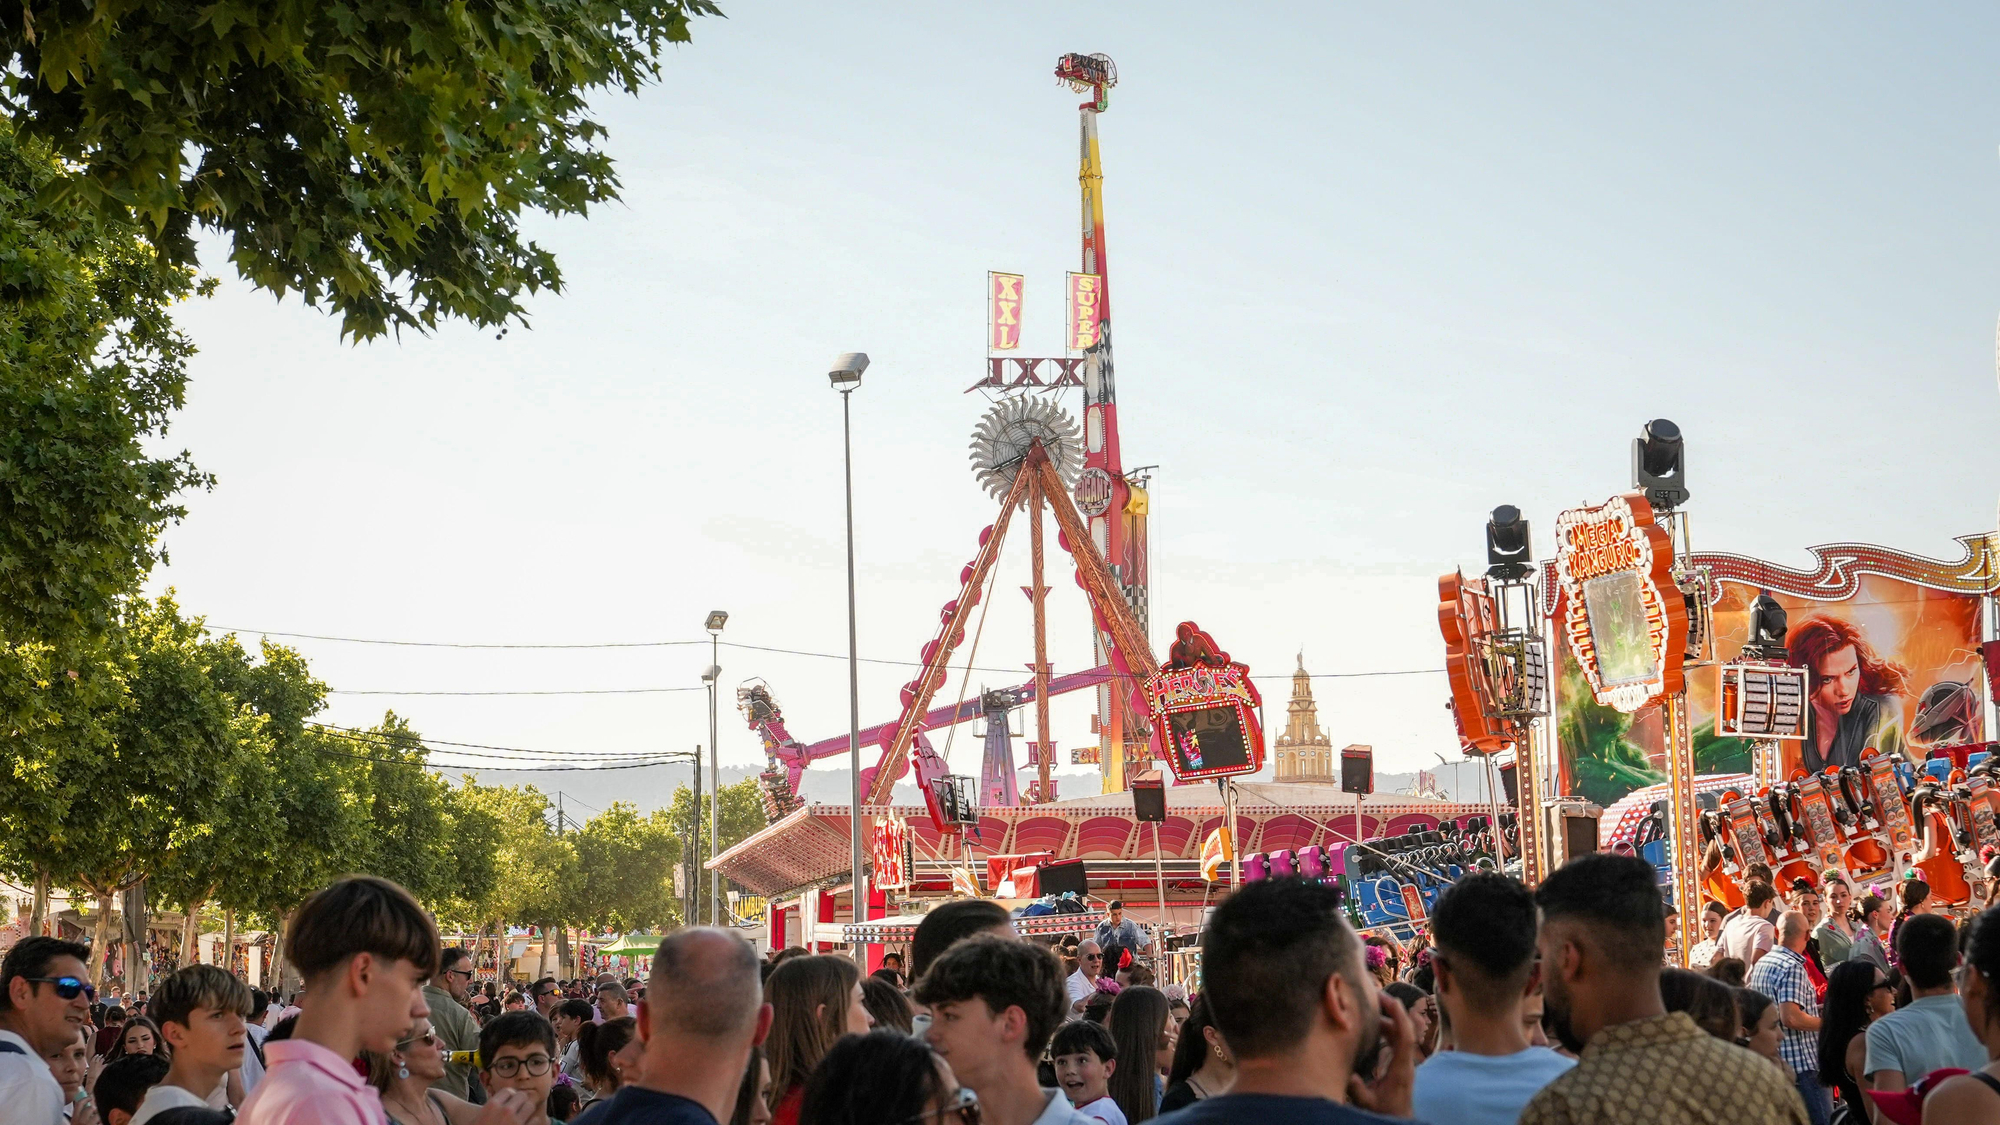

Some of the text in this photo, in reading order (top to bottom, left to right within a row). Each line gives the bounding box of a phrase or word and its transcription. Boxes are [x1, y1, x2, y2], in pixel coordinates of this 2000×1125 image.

[998, 277, 1019, 349] XXL
[1075, 277, 1096, 348] SUPER
[1076, 477, 1109, 503] GIGANT
[1572, 518, 1620, 552] MEGA
[1568, 538, 1635, 578] KANGURO
[1151, 668, 1251, 713] HEROES
[734, 896, 767, 923] HAMBUR
